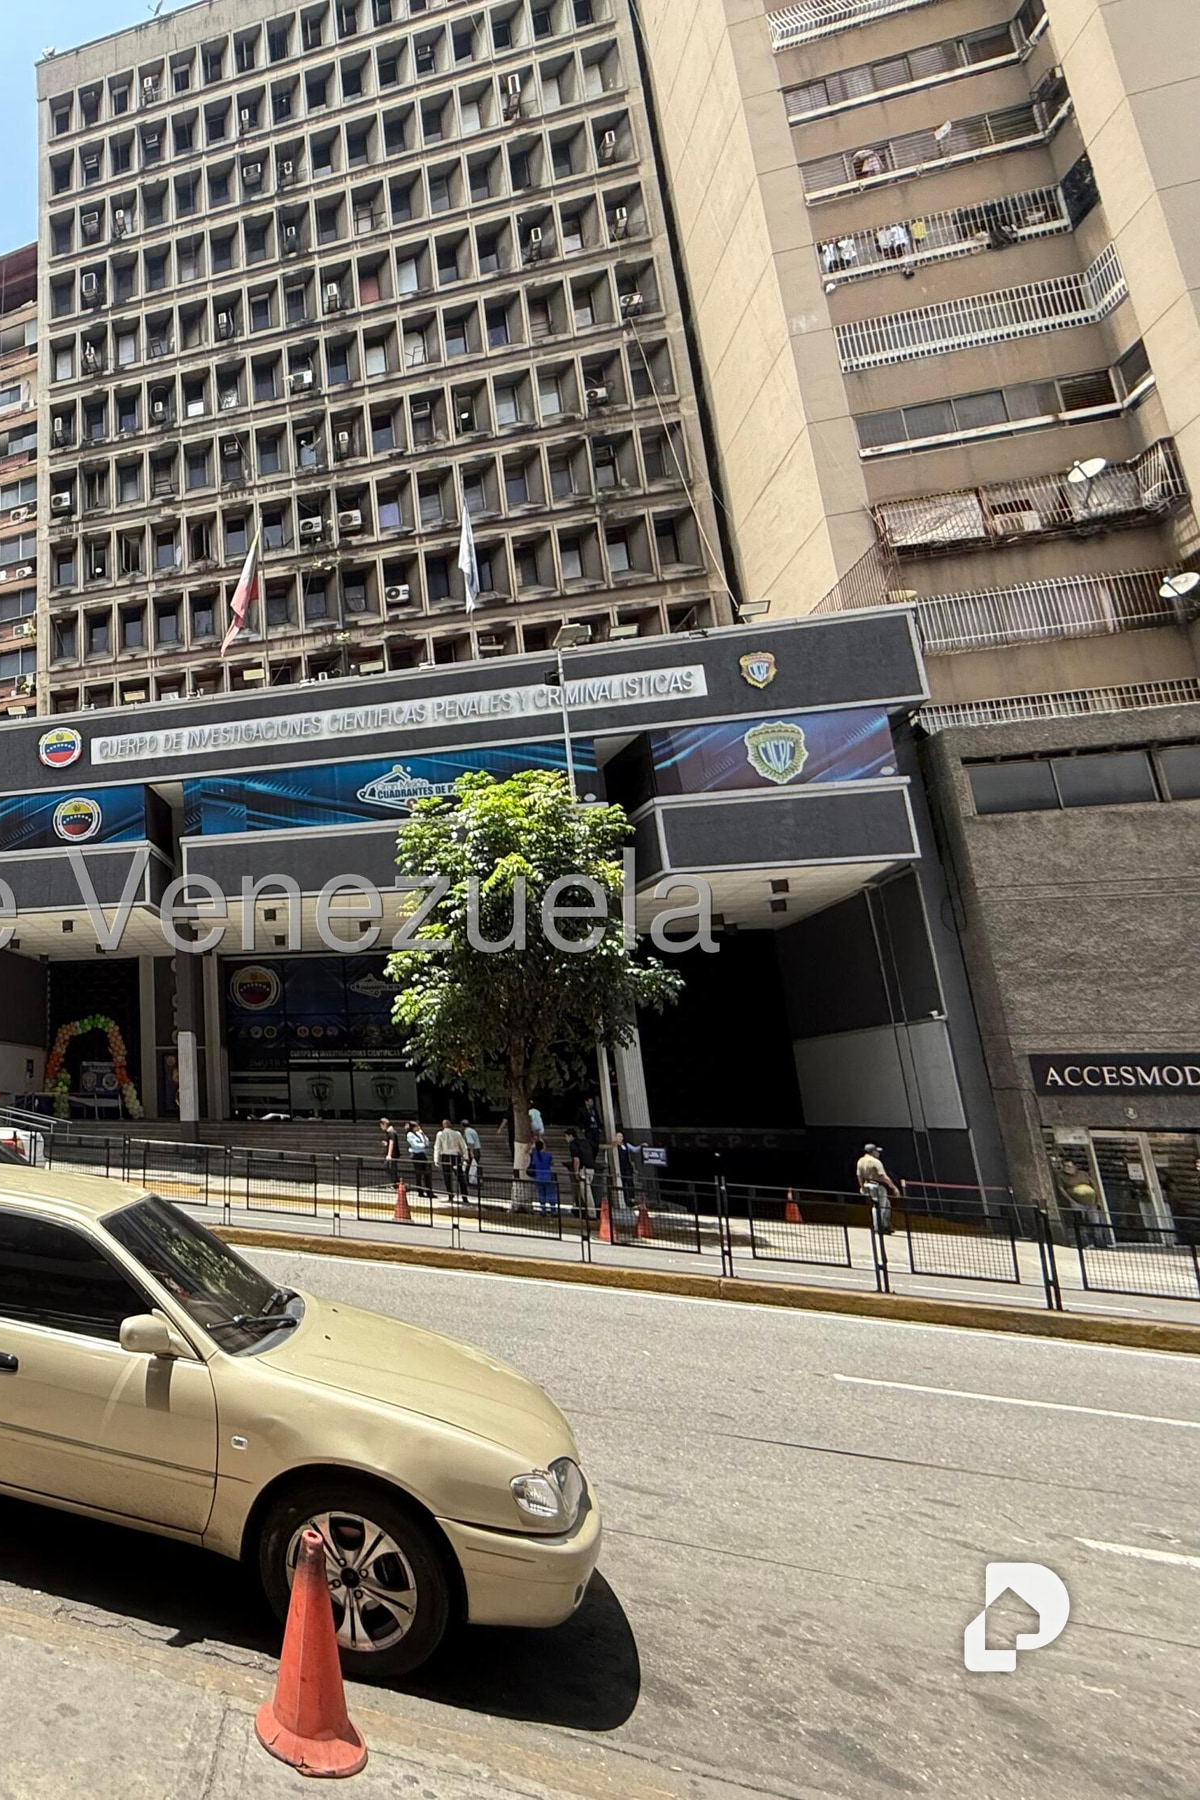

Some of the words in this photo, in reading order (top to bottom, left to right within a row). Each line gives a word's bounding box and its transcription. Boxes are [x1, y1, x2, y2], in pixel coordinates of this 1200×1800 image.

[99, 737, 157, 760] CUERPO
[163, 731, 184, 752] DE
[187, 716, 322, 750] INVESTIGACIONES
[328, 702, 426, 731] CIENTIFICAS
[432, 692, 513, 721] PENALES
[514, 690, 529, 713] Y
[377, 785, 434, 800] CUADRANTES
[435, 784, 447, 795] DE
[1045, 1065, 1200, 1087] ACCESMOD
